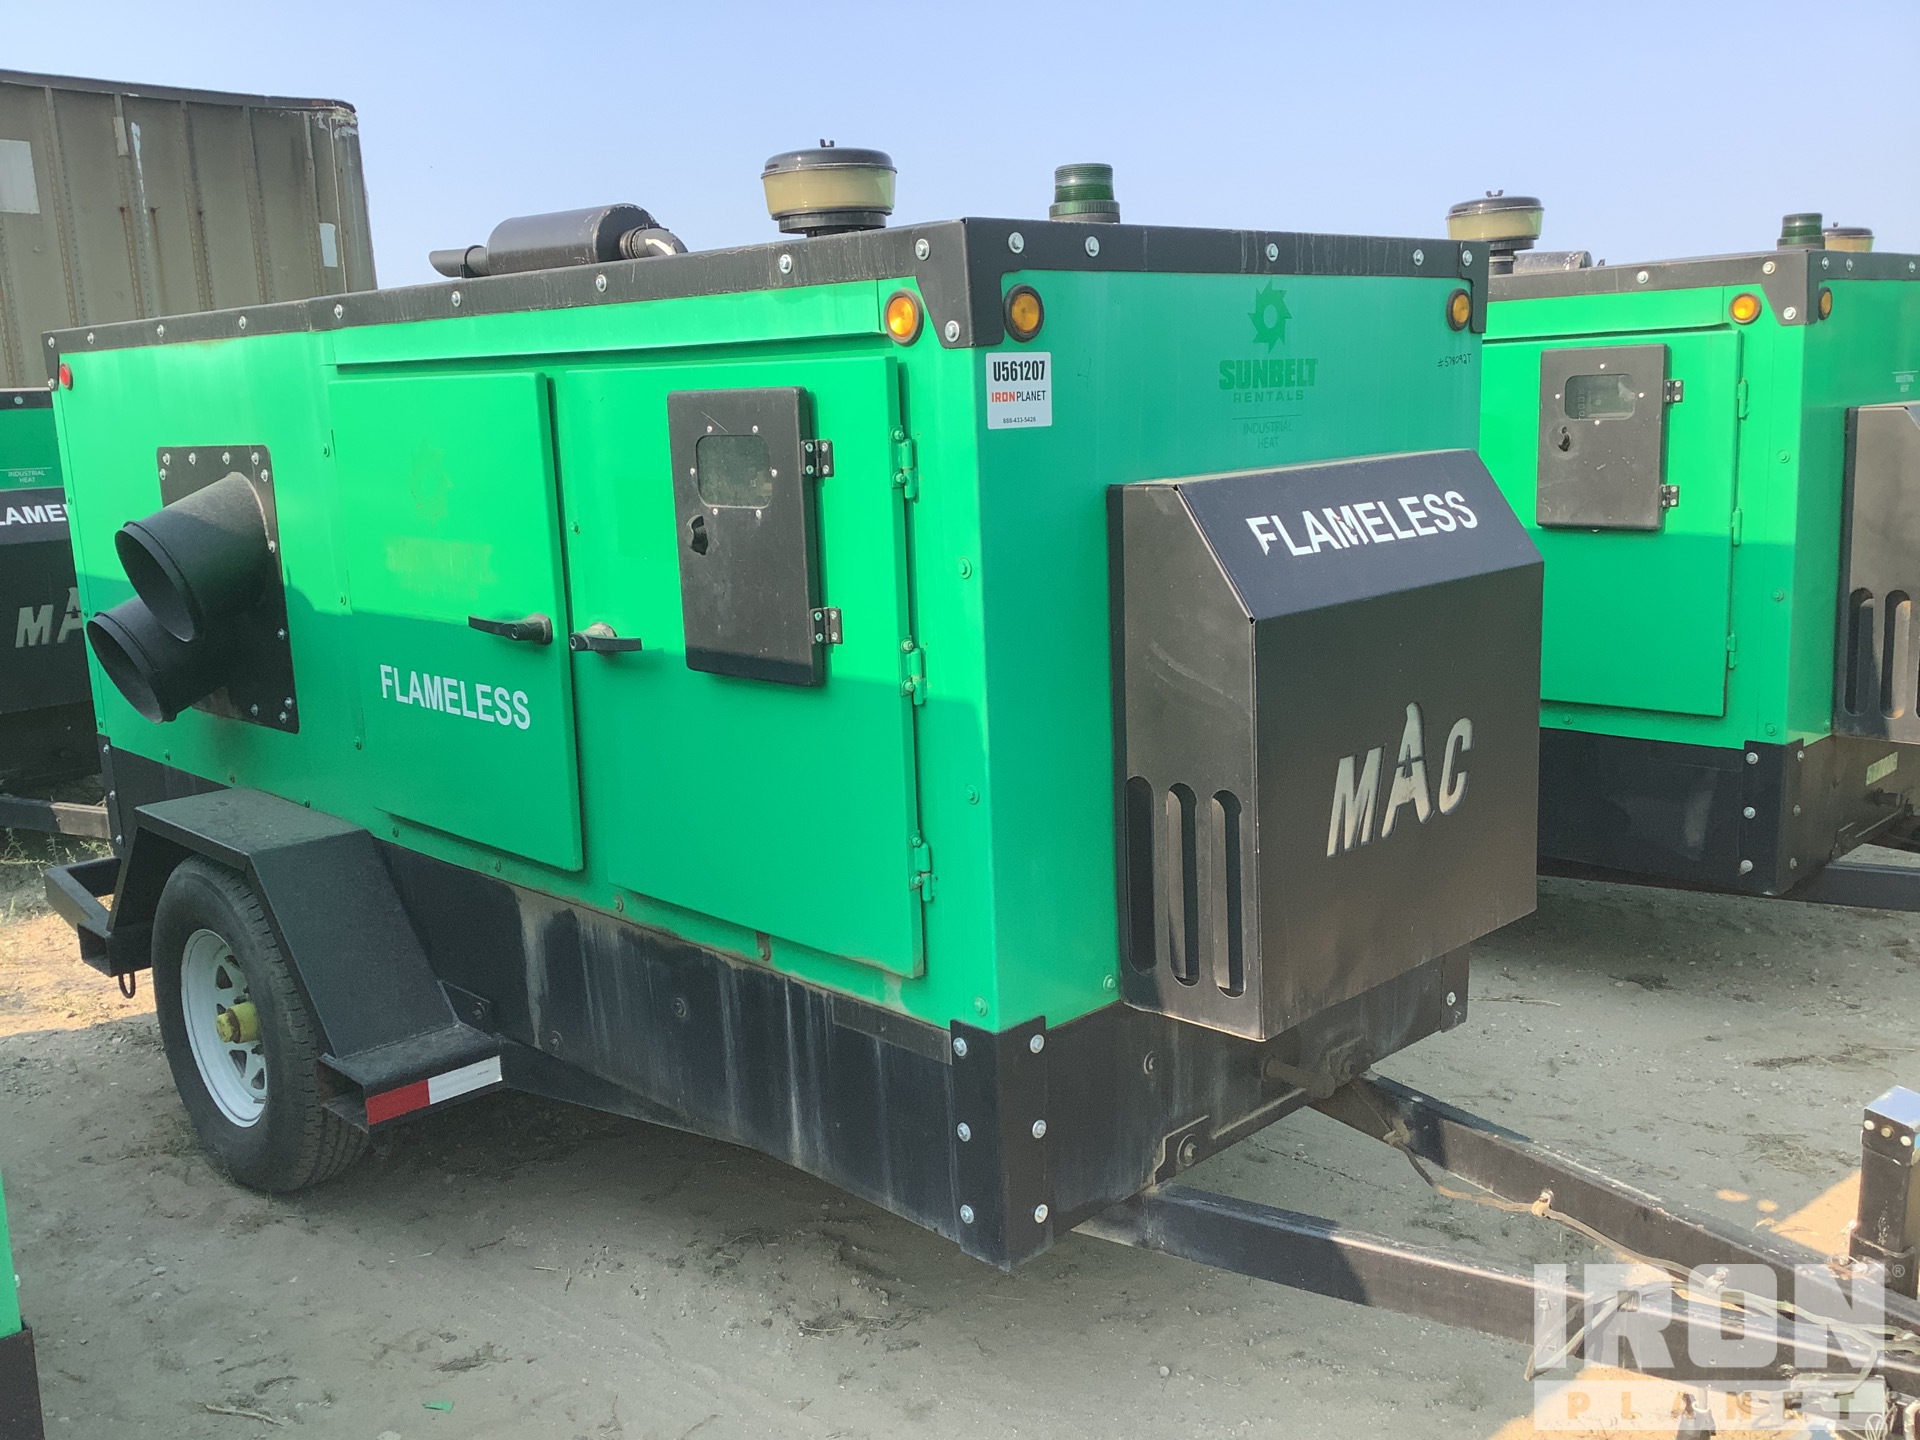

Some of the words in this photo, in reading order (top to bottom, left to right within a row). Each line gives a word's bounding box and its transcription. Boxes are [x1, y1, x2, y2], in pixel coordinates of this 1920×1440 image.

[993, 360, 1046, 382] U561207
[1219, 358, 1318, 390] SUNBELT
[1233, 389, 1304, 403] RENTALS
[1243, 421, 1293, 435] INDUSTRIAL
[1257, 437, 1279, 449] HEAT
[1246, 491, 1479, 557] FLAMELESS
[380, 664, 531, 730] FLAMELESS
[1326, 702, 1474, 859] MAC
